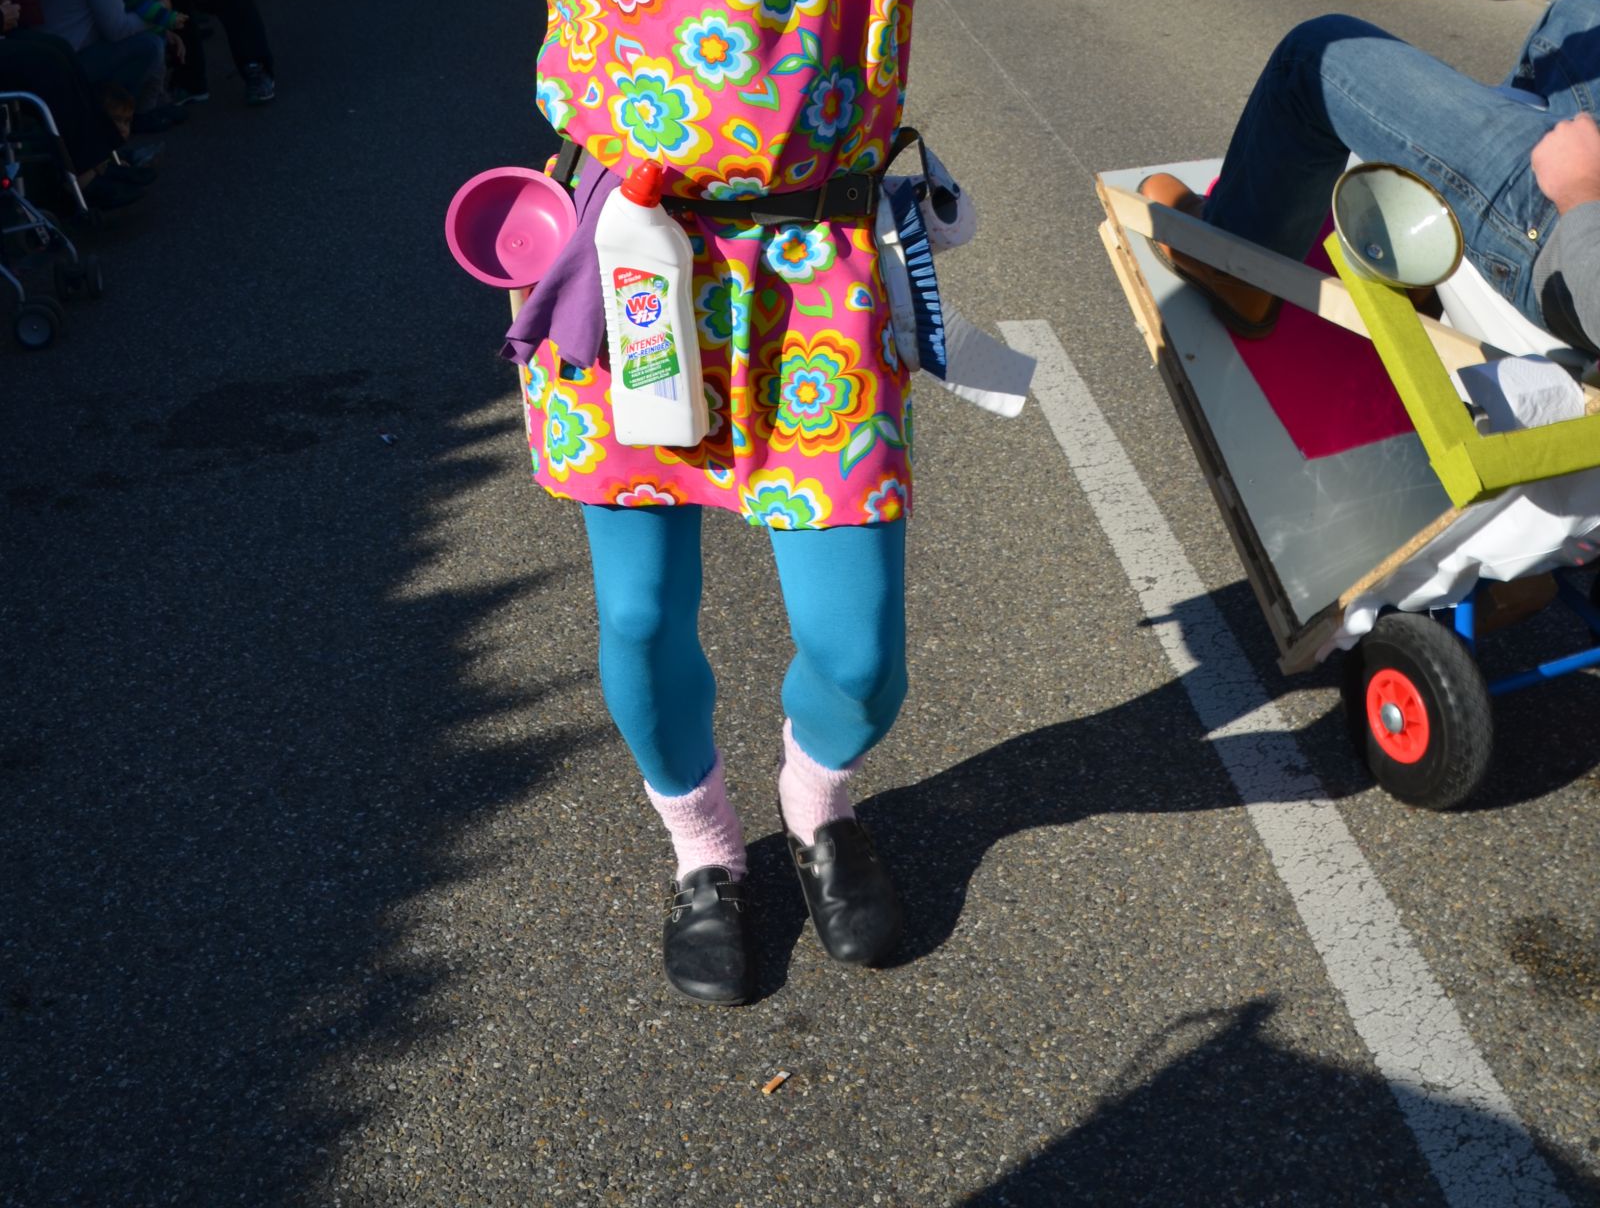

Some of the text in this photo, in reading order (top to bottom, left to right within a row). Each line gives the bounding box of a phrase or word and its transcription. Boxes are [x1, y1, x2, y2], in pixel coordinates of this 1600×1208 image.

[627, 293, 658, 313] WC
[630, 309, 657, 324] fix
[626, 332, 665, 354] INTENSIV
[627, 340, 671, 359] WC-REINIGER
